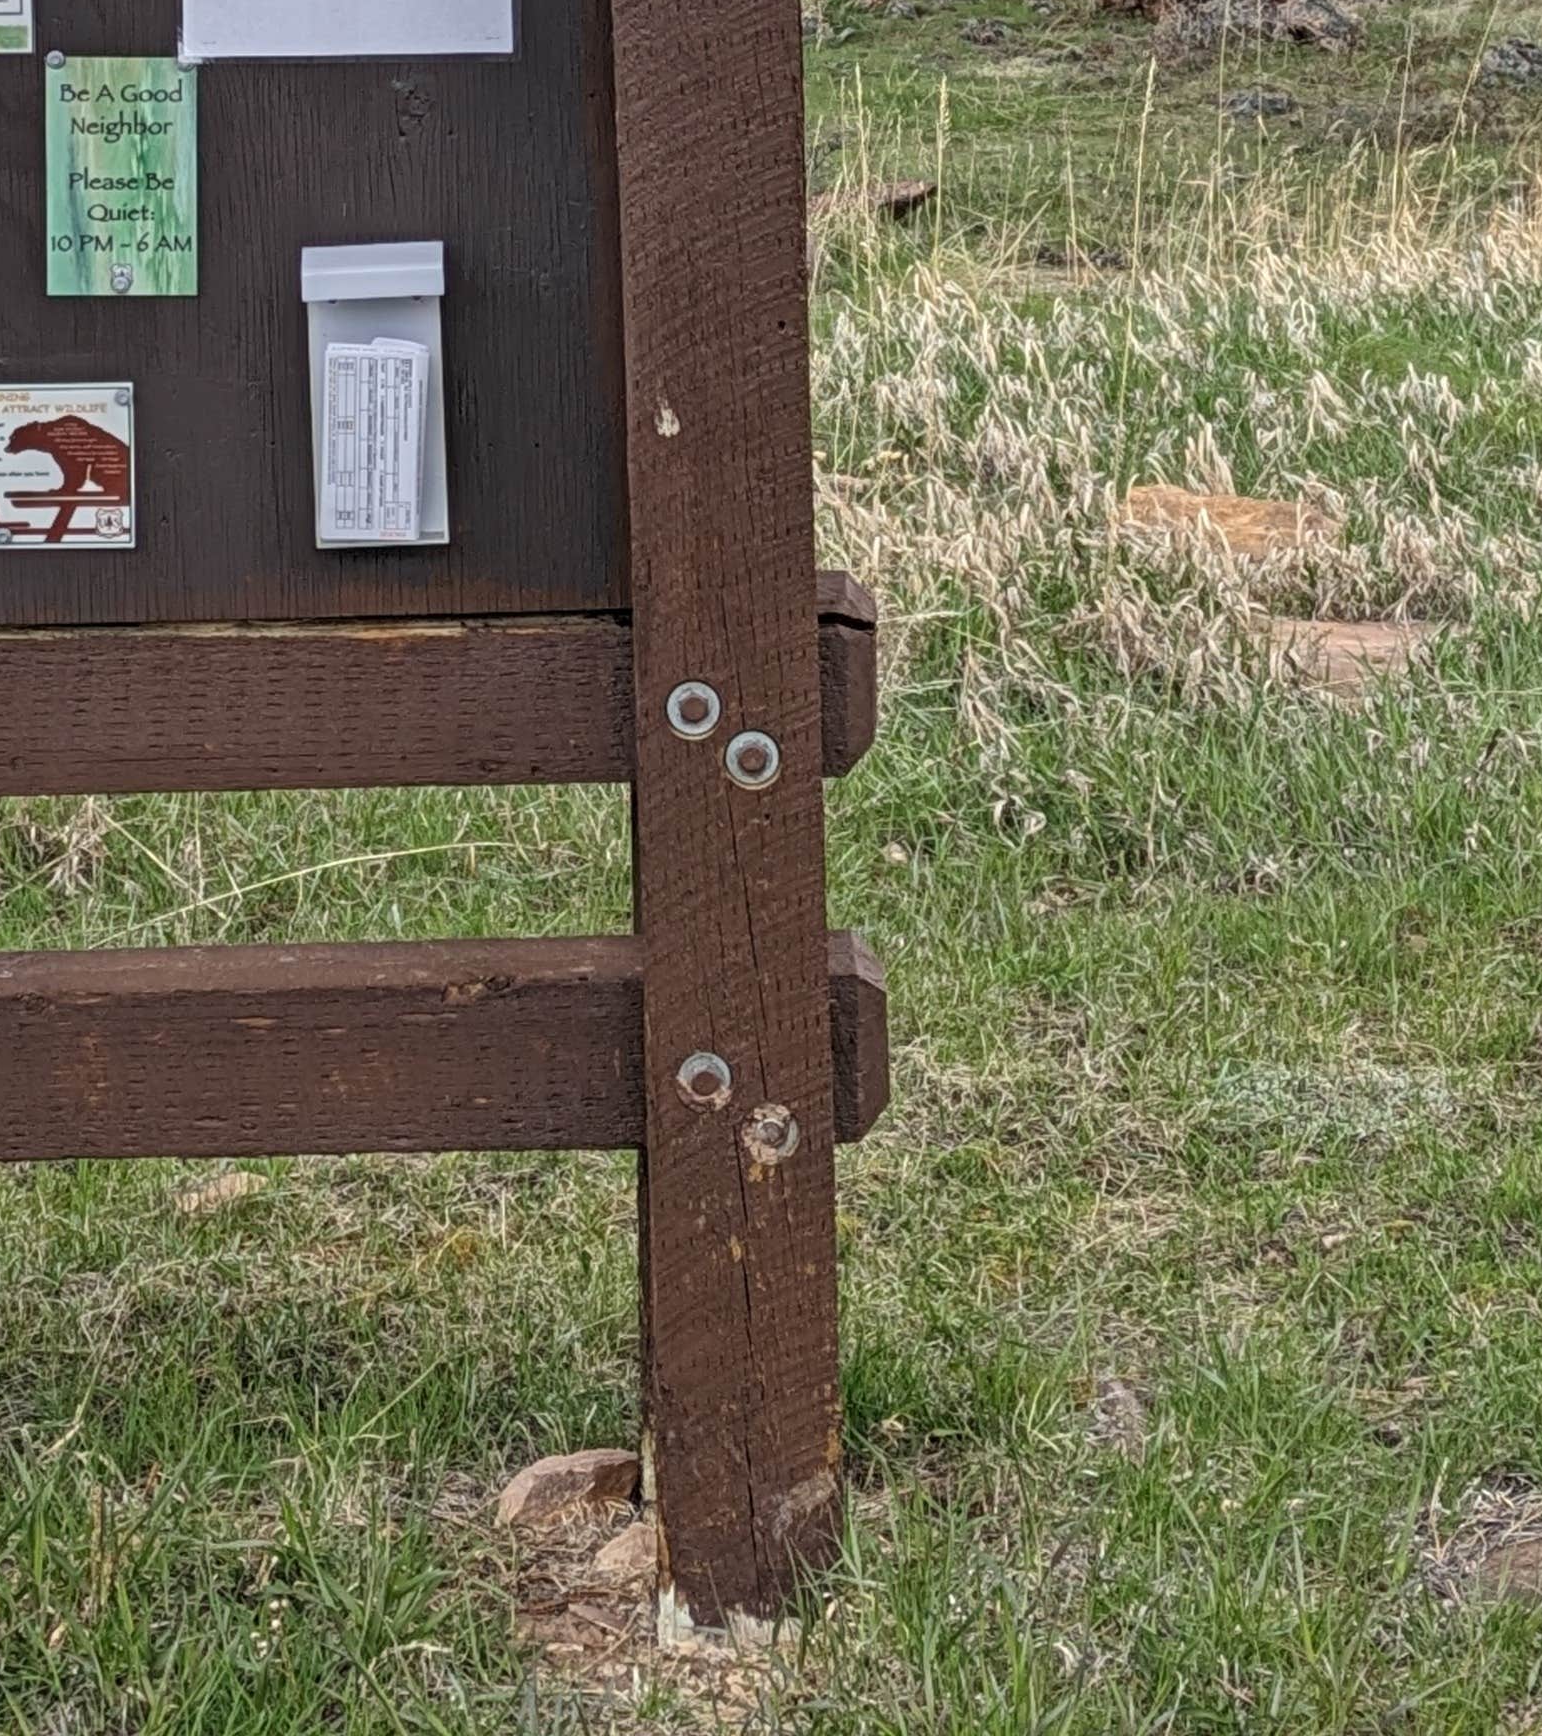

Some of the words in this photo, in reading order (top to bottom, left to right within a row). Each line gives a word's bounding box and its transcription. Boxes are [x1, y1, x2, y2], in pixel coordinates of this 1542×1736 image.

[60, 84, 91, 104] Be
[94, 84, 116, 103] A
[120, 79, 184, 103] Good
[70, 111, 174, 144] Neighbor
[68, 167, 140, 192] Please
[145, 171, 176, 192] Be
[87, 203, 157, 224] Quiet:
[51, 234, 74, 253] 10
[80, 234, 114, 253] PM
[137, 232, 149, 252] 6
[154, 234, 194, 252] AM
[2, 403, 51, 414] ATTRACT
